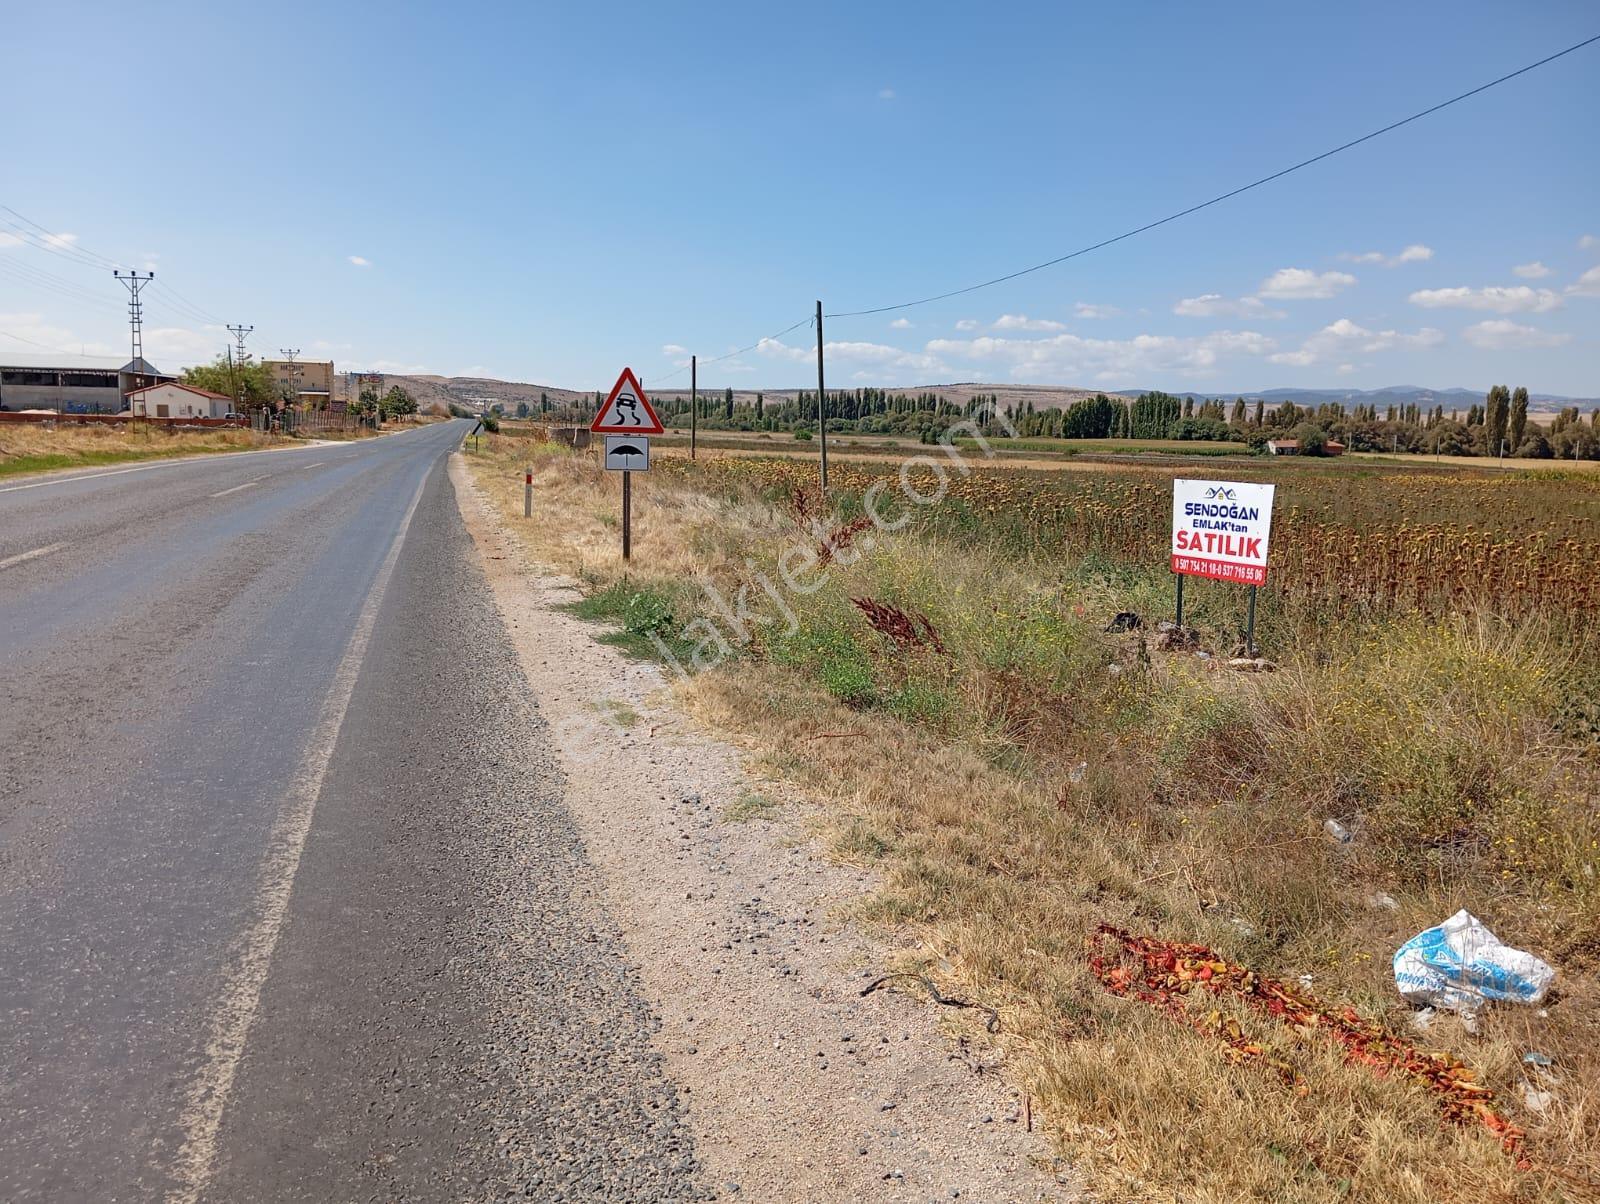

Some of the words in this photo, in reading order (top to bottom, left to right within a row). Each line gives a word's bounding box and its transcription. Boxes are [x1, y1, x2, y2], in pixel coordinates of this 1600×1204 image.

[1177, 530, 1261, 559] SATILIK
[1175, 558, 1179, 569] 0
[1180, 559, 1189, 571] 507
[1190, 560, 1200, 572] 754
[1201, 561, 1208, 573] 21
[1222, 565, 1233, 577] 537
[1246, 568, 1254, 580] 55
